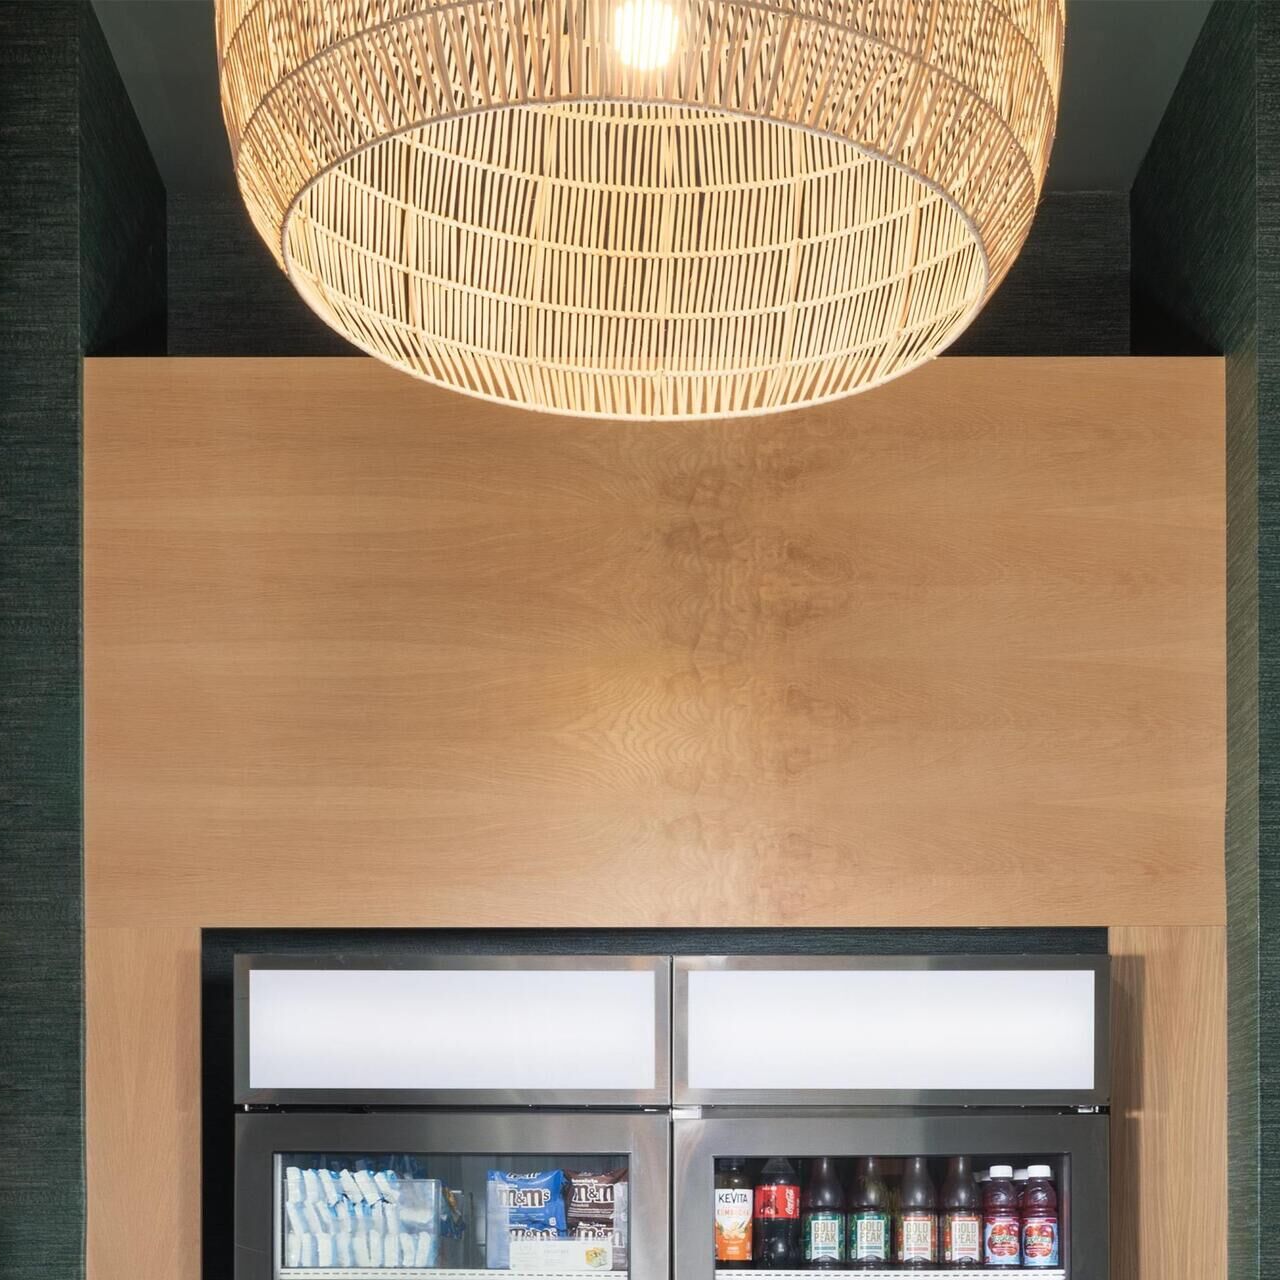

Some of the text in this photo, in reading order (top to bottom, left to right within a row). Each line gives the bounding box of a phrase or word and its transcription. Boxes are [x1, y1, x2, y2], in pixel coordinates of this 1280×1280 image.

[718, 1193, 748, 1204] KEVITA
[813, 1221, 836, 1232] GOLD
[859, 1221, 882, 1232] GOLD
[906, 1222, 928, 1233] GOLD
[813, 1232, 837, 1242] PEAK
[859, 1232, 882, 1243] PEAK
[906, 1233, 929, 1243] PEAK
[955, 1233, 977, 1243] PEAK
